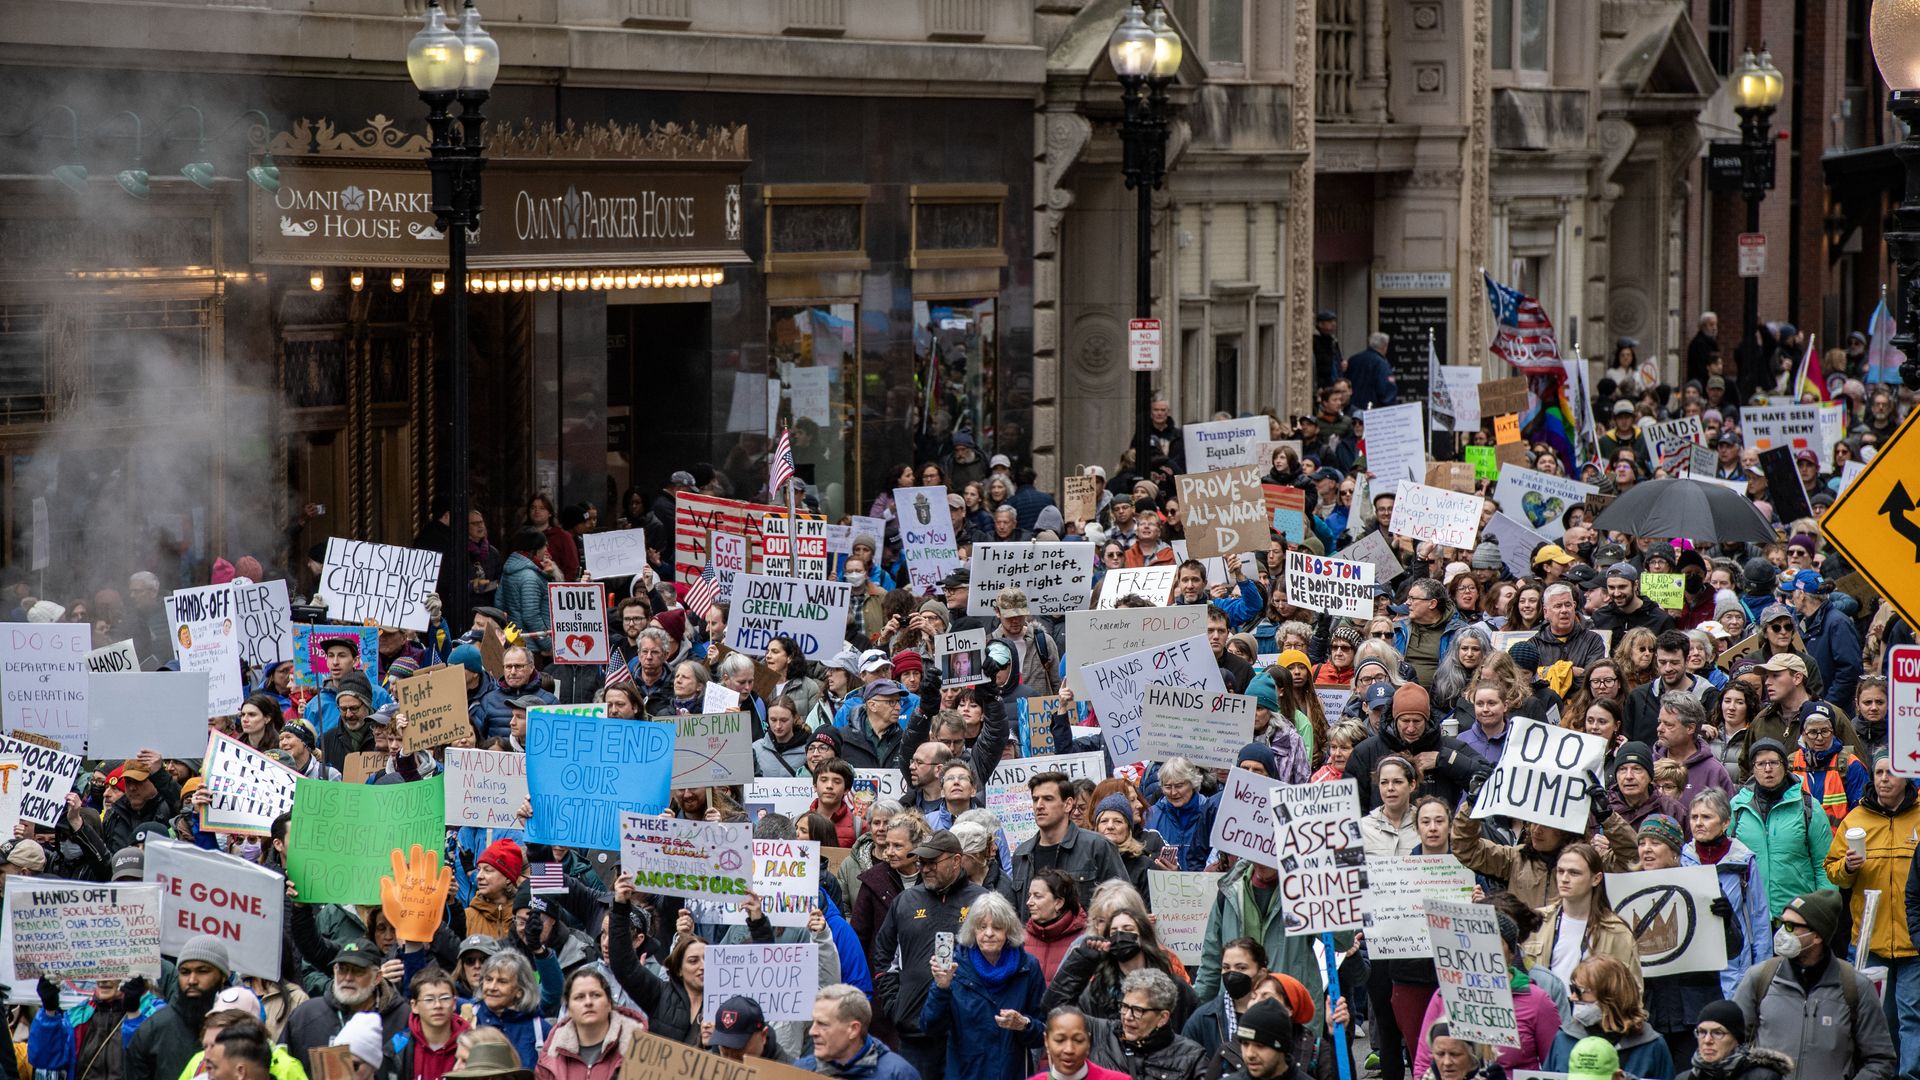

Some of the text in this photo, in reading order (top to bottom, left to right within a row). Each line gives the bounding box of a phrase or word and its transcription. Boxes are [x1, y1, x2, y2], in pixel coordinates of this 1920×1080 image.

[275, 186, 433, 213] OMNI PARKE
[515, 190, 694, 241] OMNI PARKER HOUSE
[322, 214, 402, 239] HOUSE
[1744, 411, 1815, 422] WE HAVE SEEN
[1196, 428, 1256, 445] Trumpism
[1648, 418, 1698, 442] HANDS
[1753, 425, 1814, 435] THE ENEMY
[1206, 446, 1246, 460] Equals
[1181, 466, 1261, 504] PROVE US
[1510, 478, 1585, 501] WE ARE SO SORRY
[1186, 499, 1268, 527] ALL WRONG
[1394, 504, 1471, 528] cheap eggs but
[766, 520, 784, 534] ALL
[807, 522, 824, 535] MY
[1392, 517, 1465, 545] got MEASLES
[586, 534, 637, 554] HANDS
[1215, 527, 1240, 553] D
[327, 537, 440, 579] LEGISLATURE
[594, 553, 631, 570] OFF
[715, 554, 742, 571] DOGE
[906, 549, 922, 561] CAN
[980, 546, 1064, 561] This is not
[997, 559, 1081, 576] right or left,
[1290, 553, 1304, 572] IN
[1305, 556, 1361, 580] BOSTON
[328, 566, 438, 603] CHALLENGE
[978, 575, 1086, 591] this is right or
[1116, 571, 1172, 594] FREE
[1290, 574, 1375, 600] WE DON'T DEPORT
[1641, 574, 1675, 584] LET KIDS
[557, 591, 596, 611] LOVE
[747, 581, 753, 598] I
[753, 581, 798, 602] DON'T
[804, 583, 849, 607] WANT
[1291, 588, 1307, 603] WE
[1308, 592, 1343, 609] DEFEND
[336, 592, 415, 627] TRUMP
[574, 612, 582, 621] is
[742, 599, 829, 621] GREENLAND
[1040, 603, 1078, 614] Booker
[556, 622, 603, 633] RESISTANCE
[741, 617, 783, 631] I WANT
[1090, 613, 1200, 632] Remember POLIO?
[12, 629, 84, 652] DOGE
[1102, 638, 1145, 651] I don't
[5, 661, 85, 673] DEPARTMENT
[88, 649, 132, 673] HANDS
[39, 674, 51, 683] OF
[1095, 658, 1143, 691] HANDS
[8, 689, 84, 702] GENERATING
[402, 681, 433, 708] Fight
[1318, 692, 1343, 700] Courage
[22, 707, 80, 729] EVIL
[404, 703, 453, 727] Ignorance
[419, 717, 443, 734] NOT
[711, 714, 740, 735] PLAN
[408, 726, 466, 752] Immigrants
[528, 718, 670, 765] DEFEND
[446, 752, 460, 768] The
[460, 752, 496, 771] MAD
[463, 775, 507, 796] Making
[560, 763, 619, 795] OUR
[463, 790, 508, 805] America
[1234, 779, 1267, 808] We're
[1275, 783, 1353, 804] TRUMP/ELON
[1481, 765, 1587, 818] TRUMP
[302, 782, 435, 823] USE YOUR
[462, 806, 518, 836] Go Away
[1252, 809, 1269, 825] for
[624, 832, 696, 848] AMERICA
[1282, 817, 1352, 857] ASSES
[764, 860, 806, 878] PLACE
[1304, 855, 1334, 869] ON A
[634, 869, 748, 896] ANCESTORS
[1153, 874, 1205, 898] USES
[1283, 868, 1361, 901] CRIME
[32, 888, 117, 908] HANDS OFF!
[156, 873, 266, 919] BE GONE,
[1162, 898, 1203, 909] COFFEE
[63, 905, 97, 917] SOCIAL
[98, 904, 145, 915] SECURITY
[1287, 895, 1363, 931] SPREE
[178, 910, 241, 941] ELON
[1425, 913, 1451, 930] TRUMP
[1453, 918, 1465, 933] IS
[1455, 933, 1471, 949] TO
[714, 948, 745, 966] Memo
[749, 951, 759, 963] to
[1437, 946, 1505, 975] BURY US
[719, 965, 801, 989] DEVOUR
[1437, 967, 1508, 990] TRUMP DOES NOT
[1457, 986, 1496, 1005] REALIZE
[1446, 1000, 1516, 1030] WE ARE SEEDS
